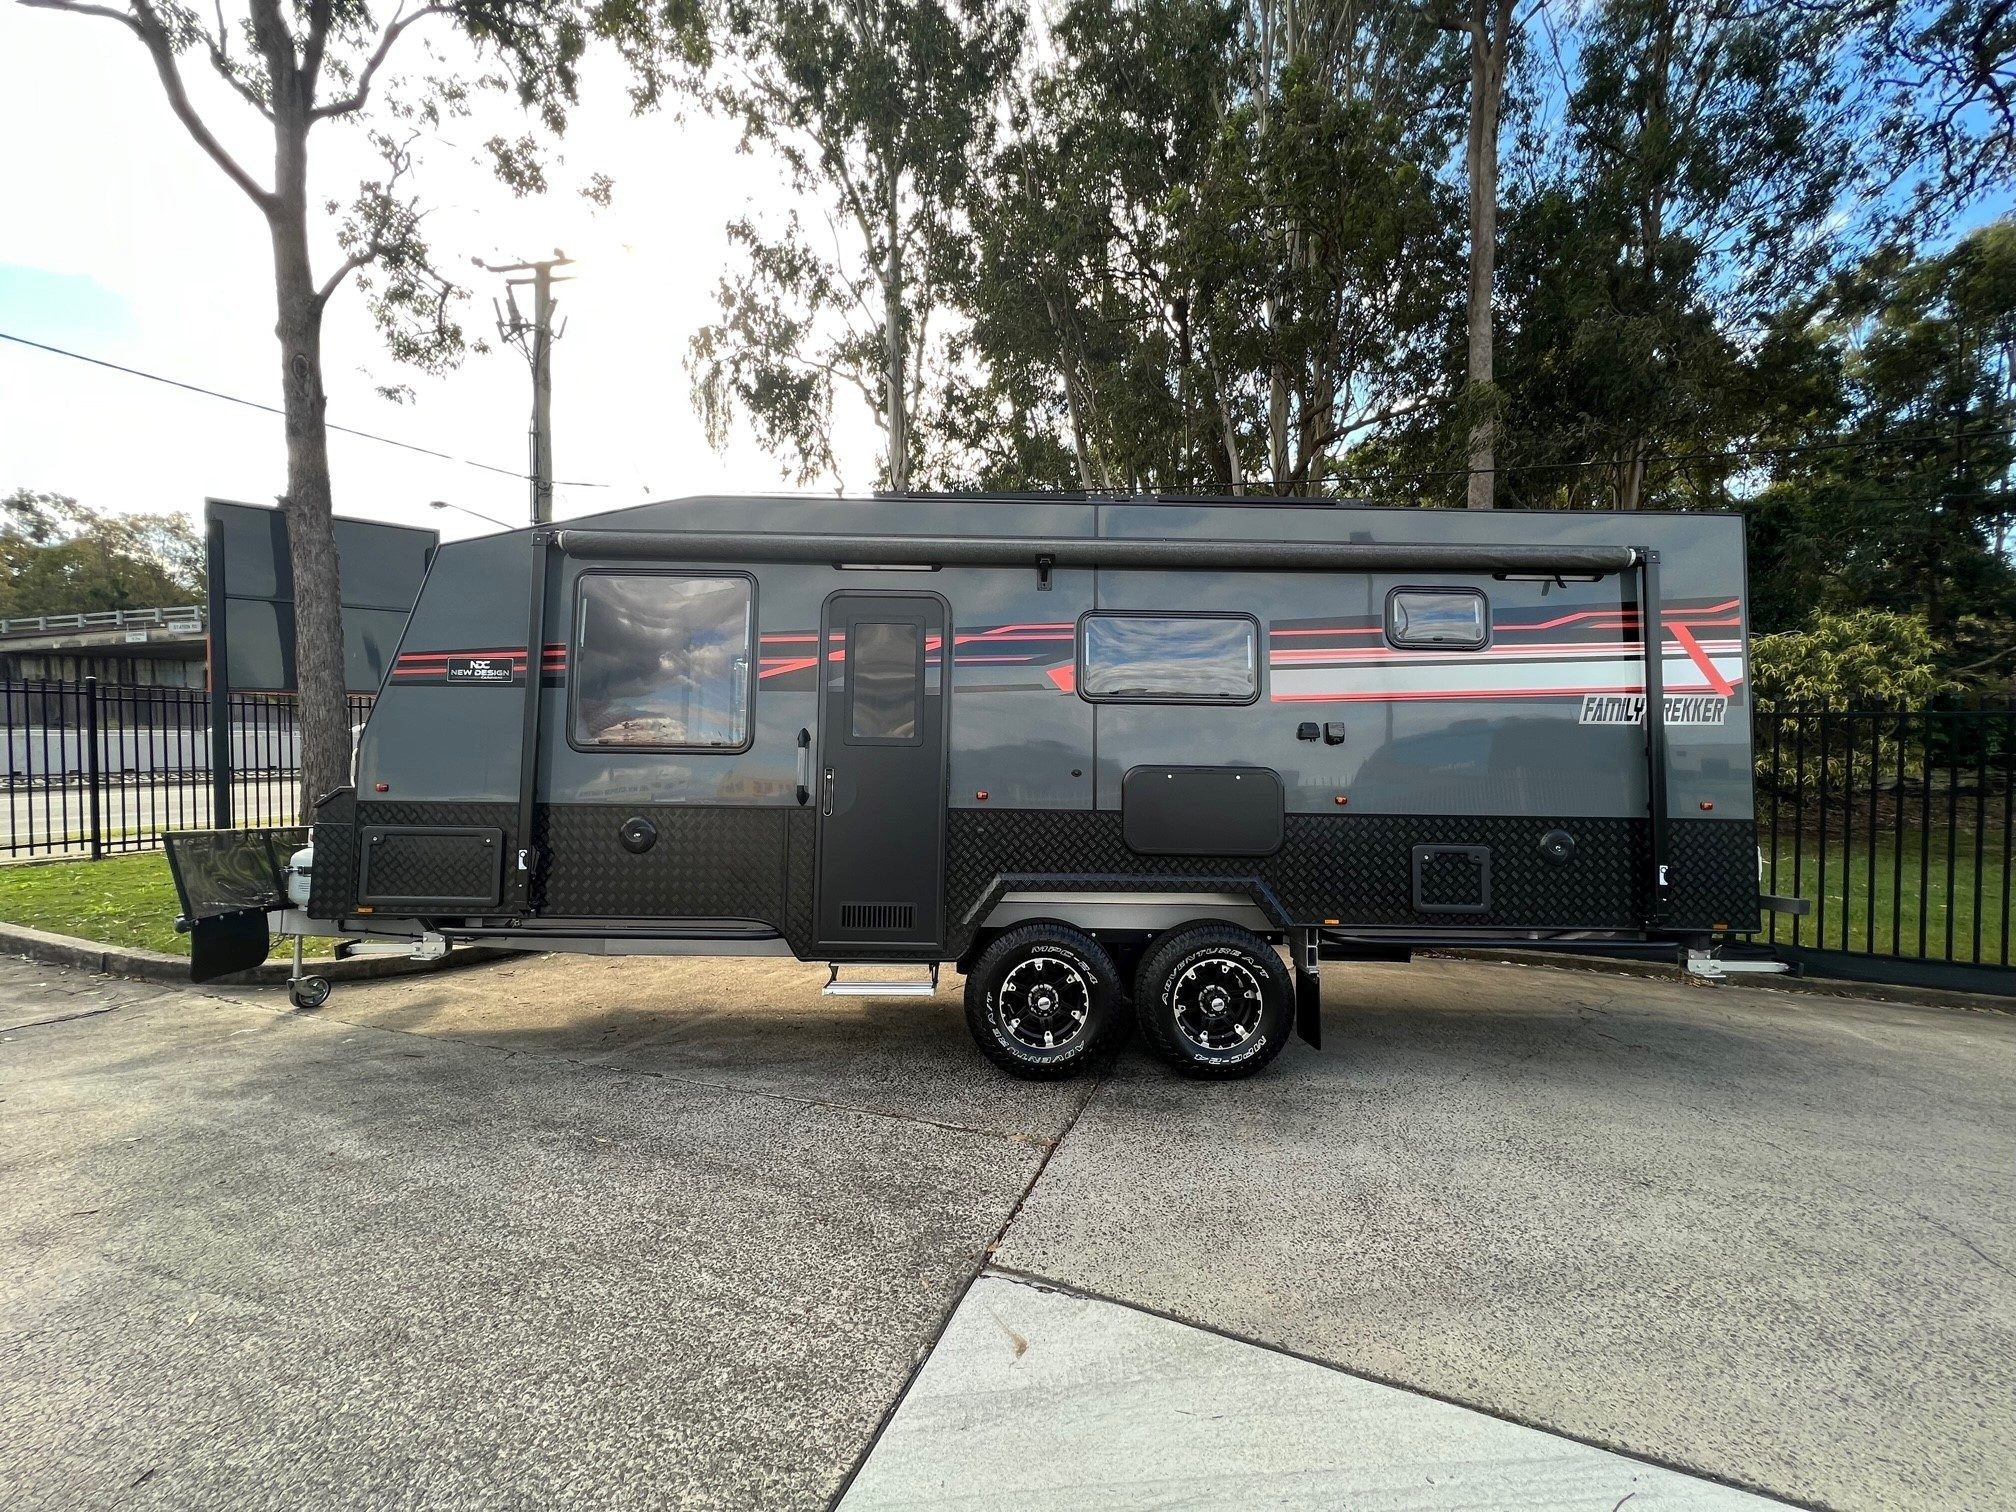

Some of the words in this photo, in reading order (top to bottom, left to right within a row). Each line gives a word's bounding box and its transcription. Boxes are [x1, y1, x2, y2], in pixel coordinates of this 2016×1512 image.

[470, 661, 490, 669] NDC
[1583, 697, 1645, 722] FAMILY
[1663, 697, 1725, 722] REKKER
[1162, 947, 1242, 1005] ADVENTURE
[1242, 956, 1269, 979] A/T
[992, 1028, 1085, 1064] ADVENTURE
